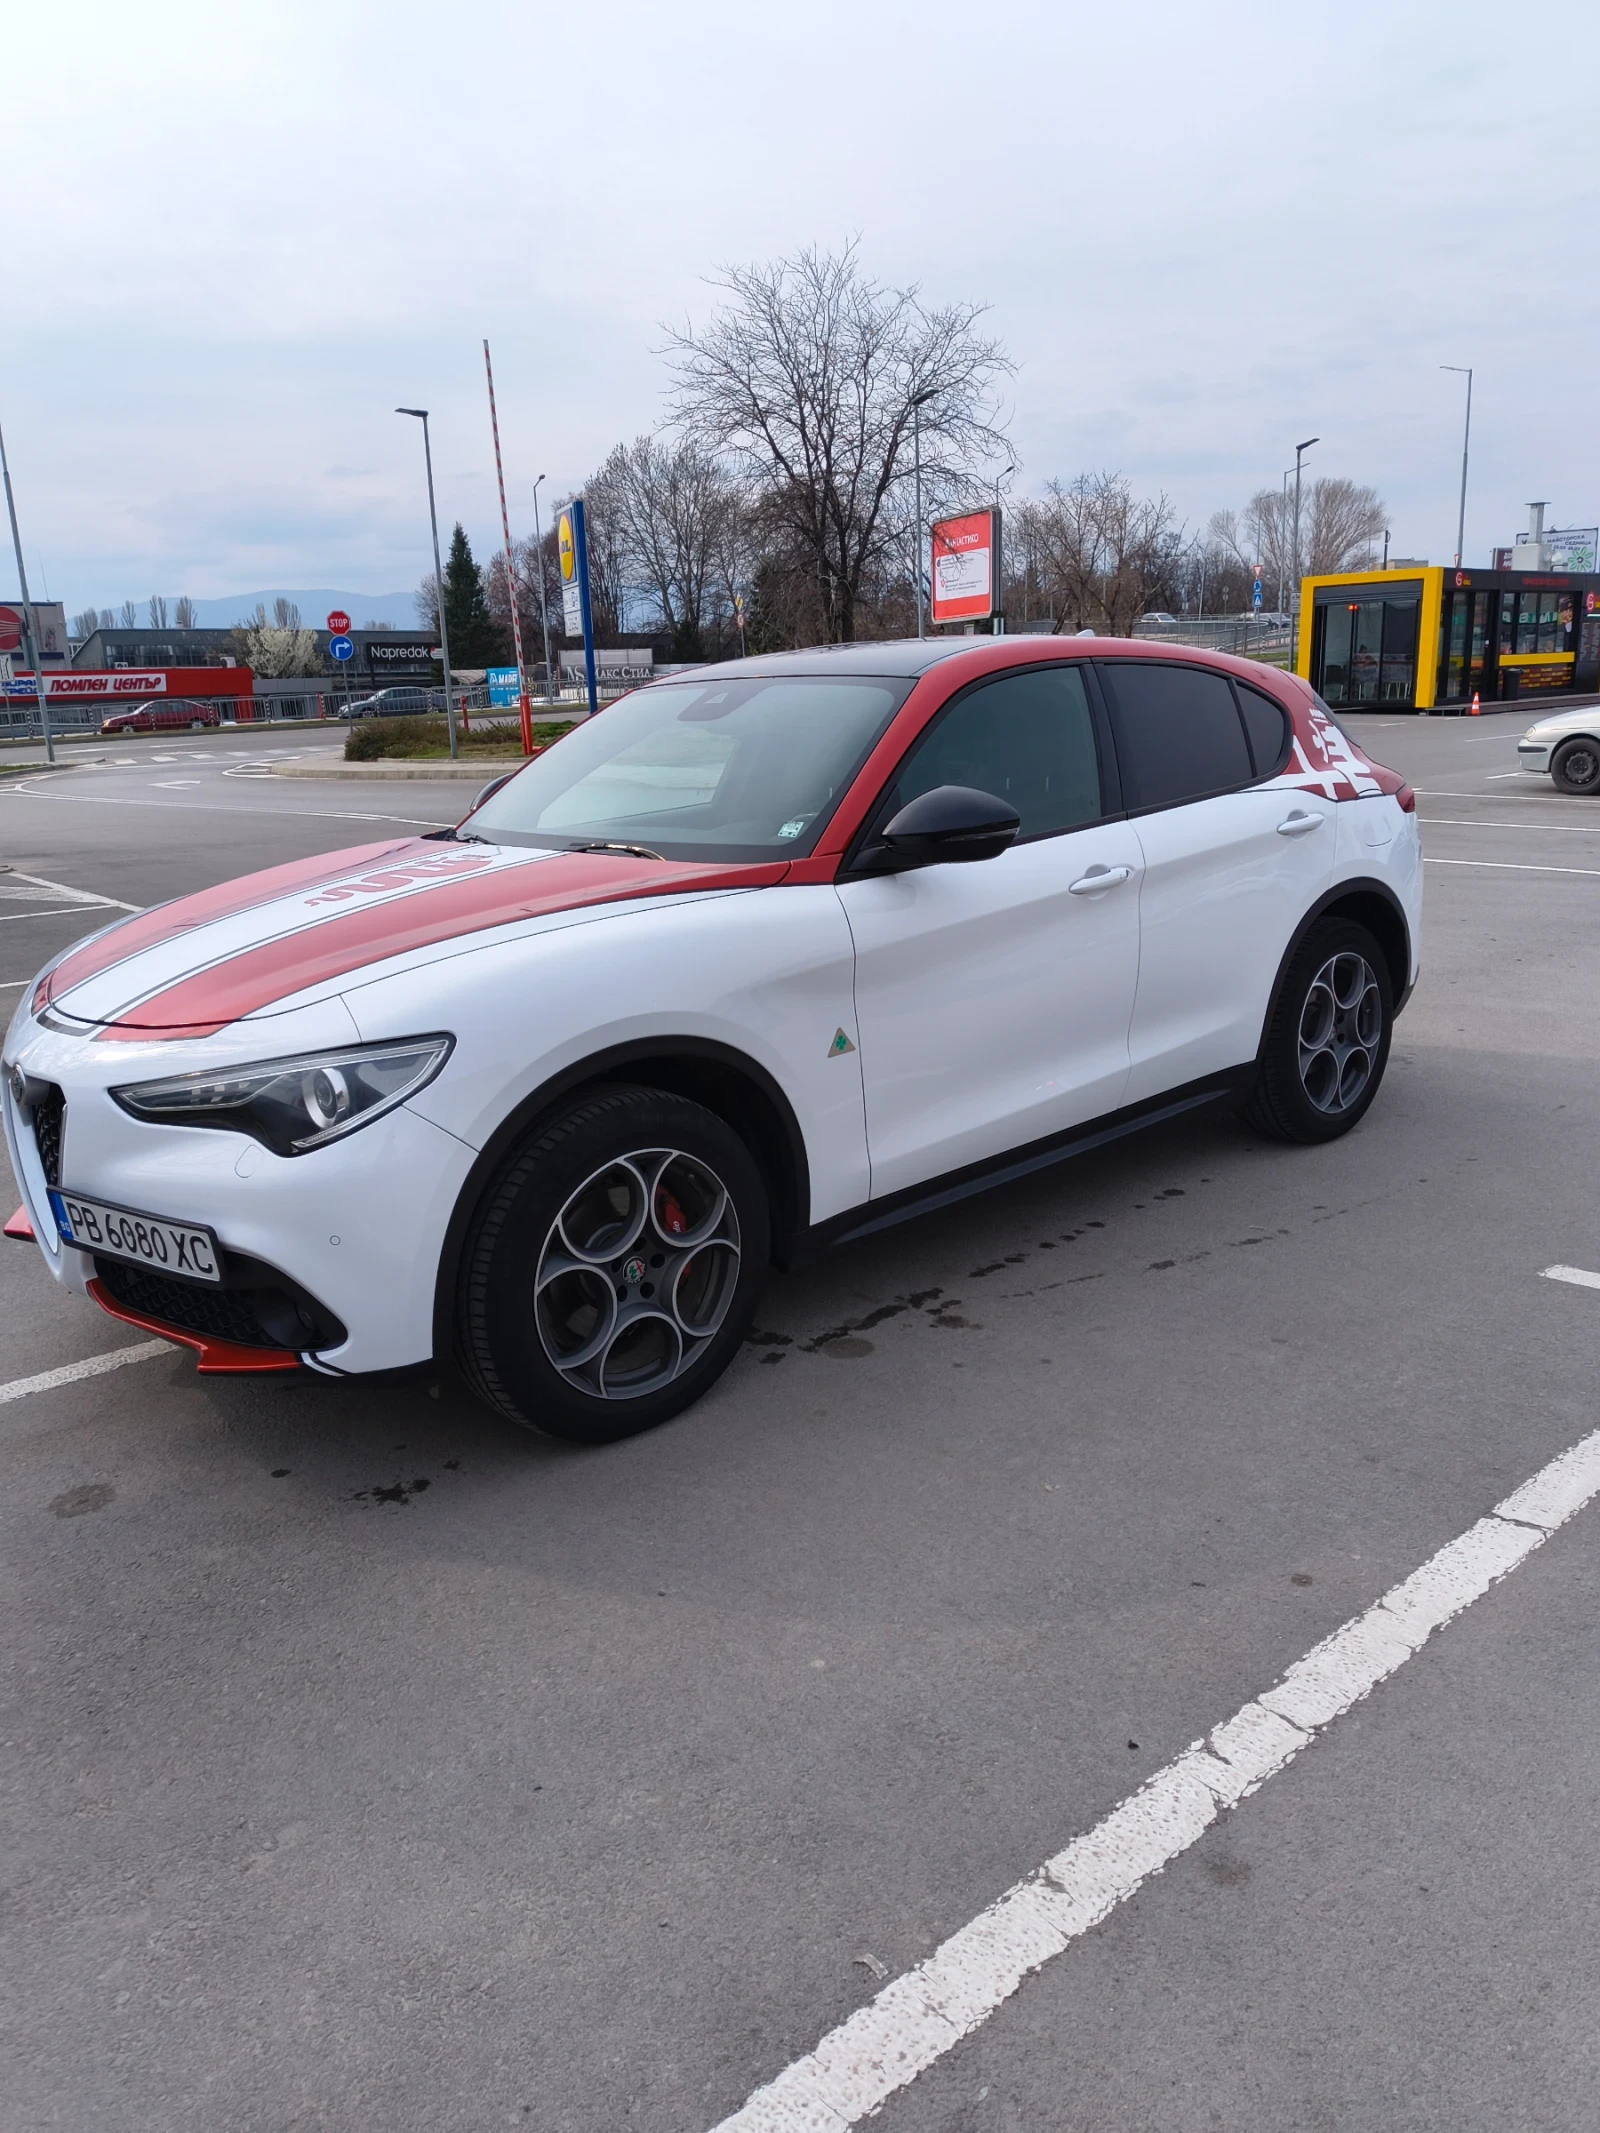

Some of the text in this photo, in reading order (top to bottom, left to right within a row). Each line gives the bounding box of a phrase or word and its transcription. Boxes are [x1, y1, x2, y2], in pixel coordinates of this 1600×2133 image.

[329, 618, 348, 628] STOP
[371, 645, 429, 660] Napredak
[50, 677, 162, 692] ПОМПЕН ЦЕНТЪР
[60, 1220, 71, 1233] BG
[65, 1201, 213, 1274] PB 6080 XC
